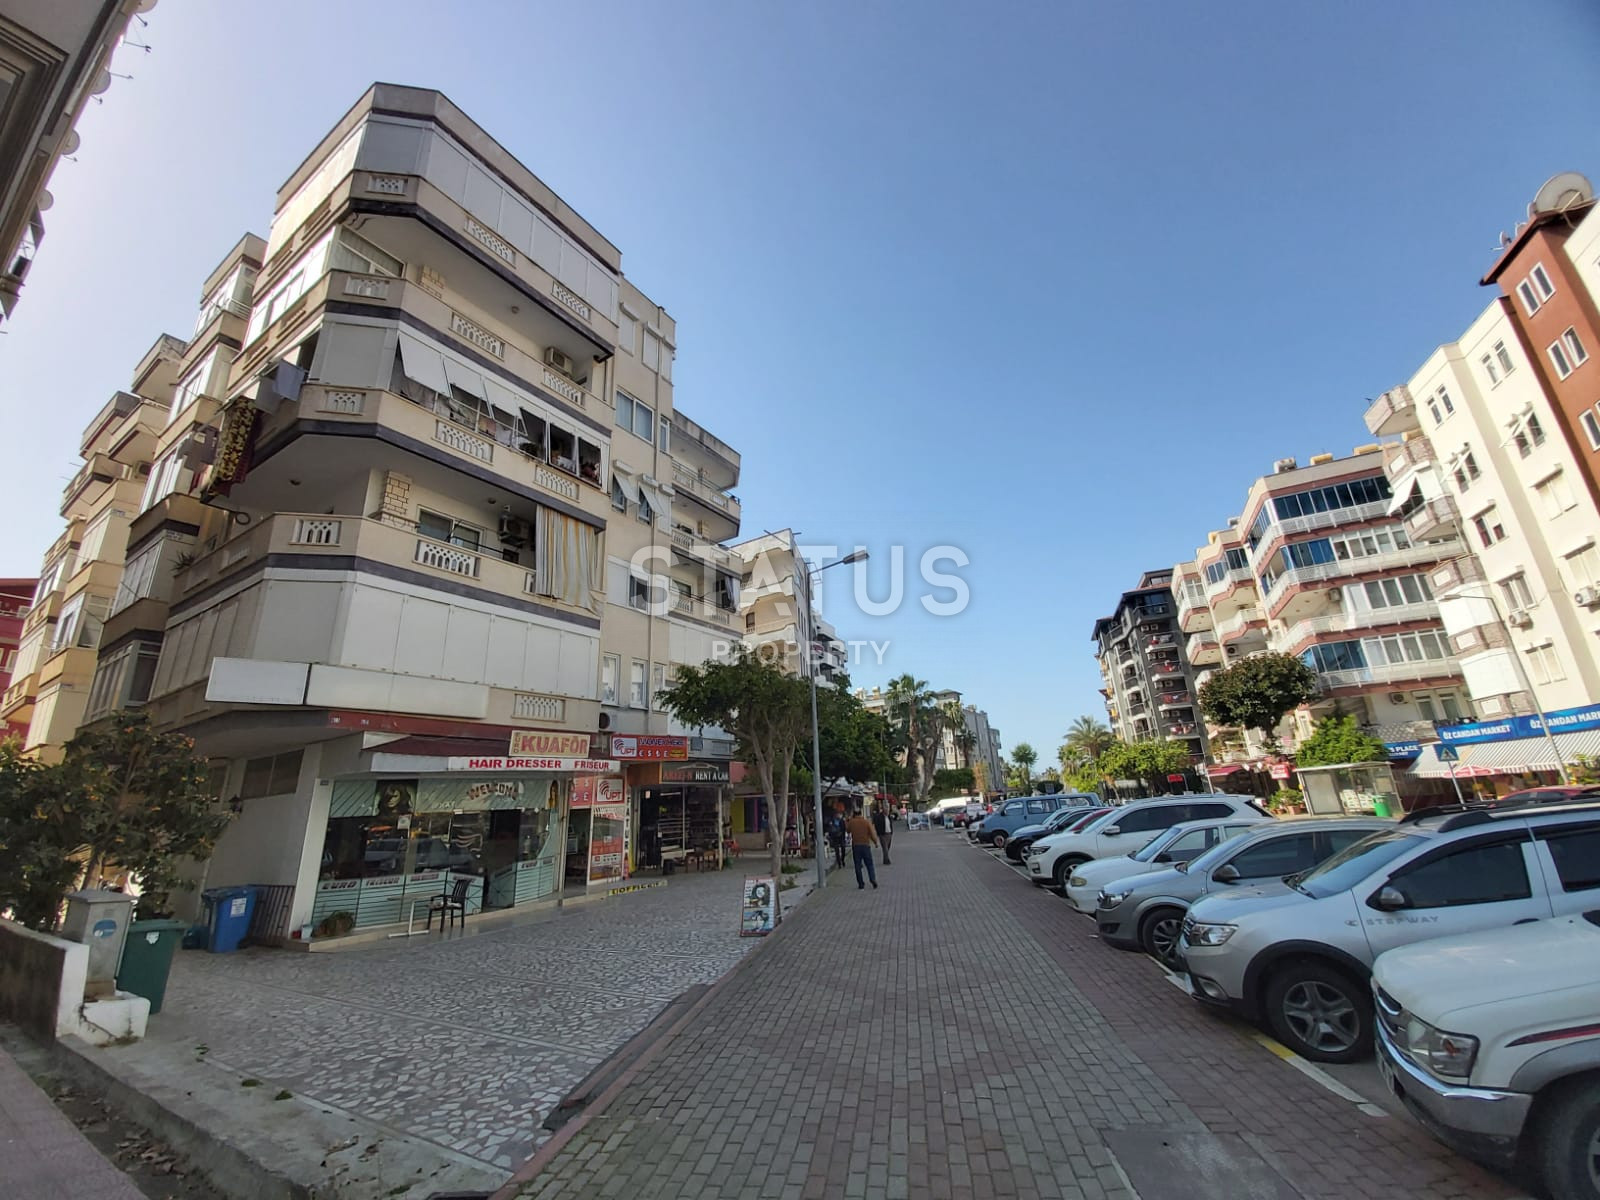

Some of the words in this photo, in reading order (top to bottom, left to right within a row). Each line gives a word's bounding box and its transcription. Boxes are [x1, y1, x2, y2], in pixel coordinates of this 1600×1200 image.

[1544, 715, 1577, 727] ANDAN
[1443, 731, 1452, 740] ÖZ
[1453, 728, 1480, 739] CANDAN
[1481, 724, 1511, 736] MARKET
[469, 759, 502, 769] HAIR
[506, 759, 562, 769] DRESSER
[574, 760, 609, 770] FRISEUR
[695, 770, 711, 781] RENT
[606, 792, 621, 800] UPT
[321, 881, 357, 890] EURO
[1366, 915, 1439, 926] STEPWAY
